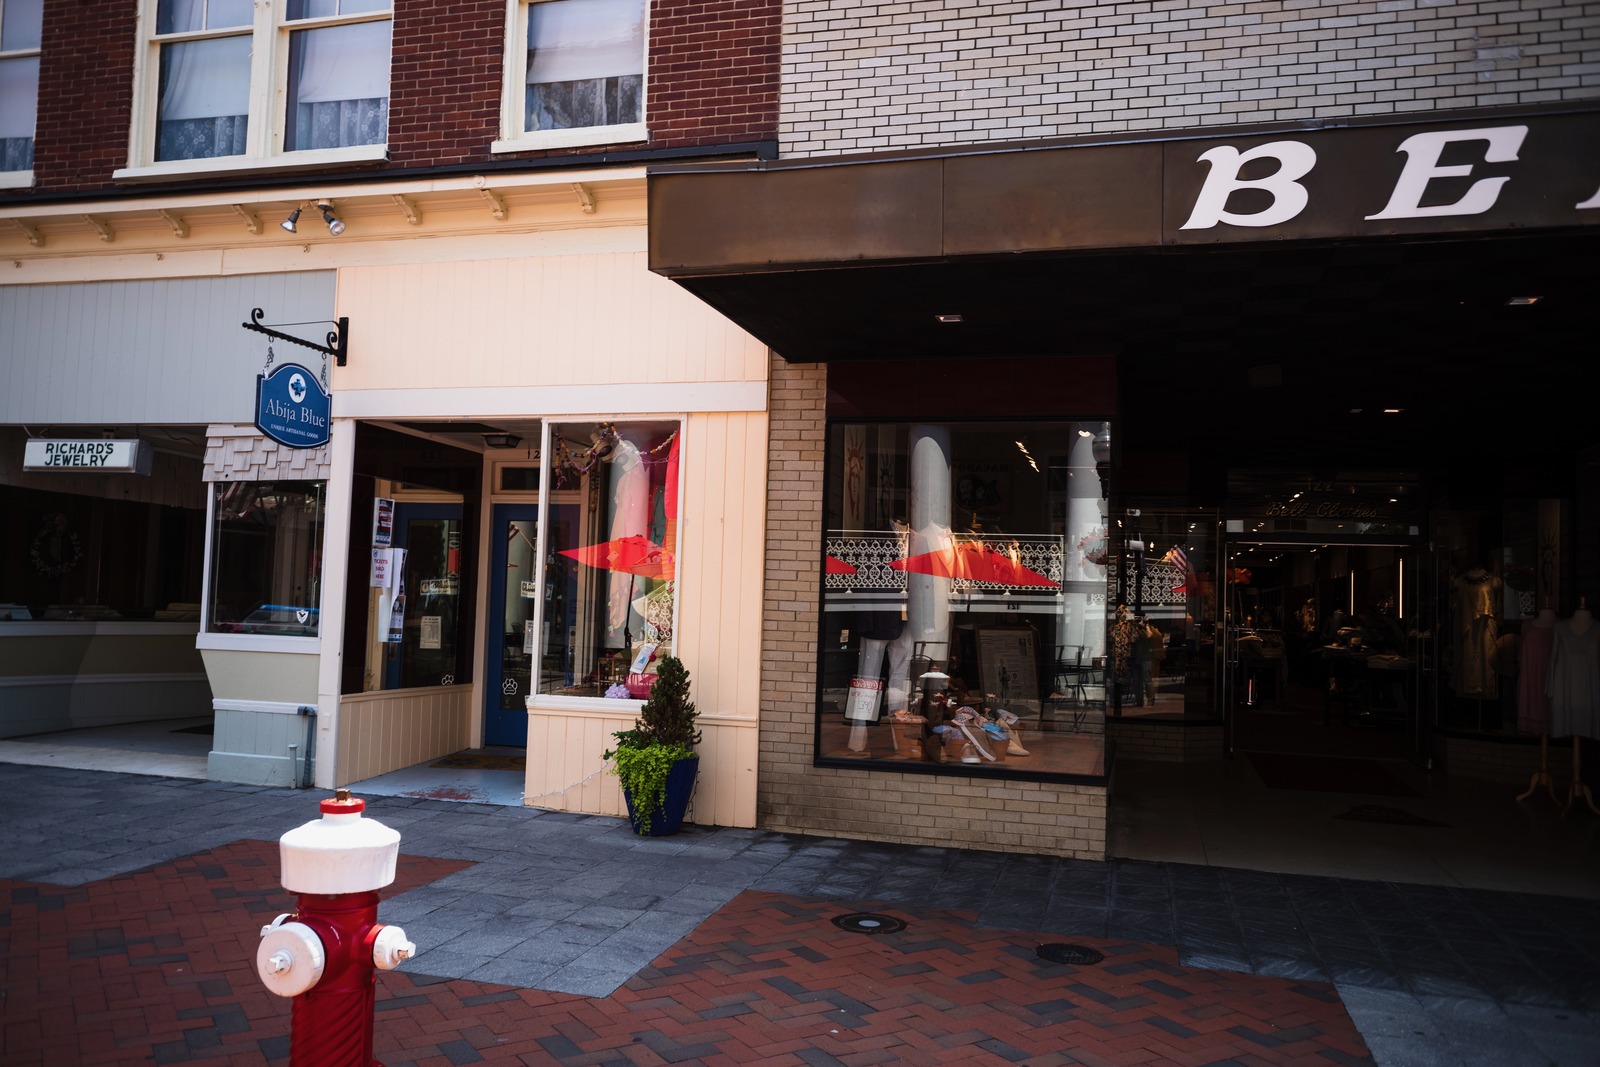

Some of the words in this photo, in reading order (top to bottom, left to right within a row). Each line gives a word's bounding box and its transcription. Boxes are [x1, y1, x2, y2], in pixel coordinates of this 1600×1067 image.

[1180, 125, 1600, 231] BE
[265, 398, 296, 424] Abija
[300, 406, 325, 428] Blue
[45, 442, 114, 455] RICHARD'S
[527, 449, 541, 460] 12
[44, 454, 109, 467] JEWELRY
[1265, 501, 1310, 518] Bell
